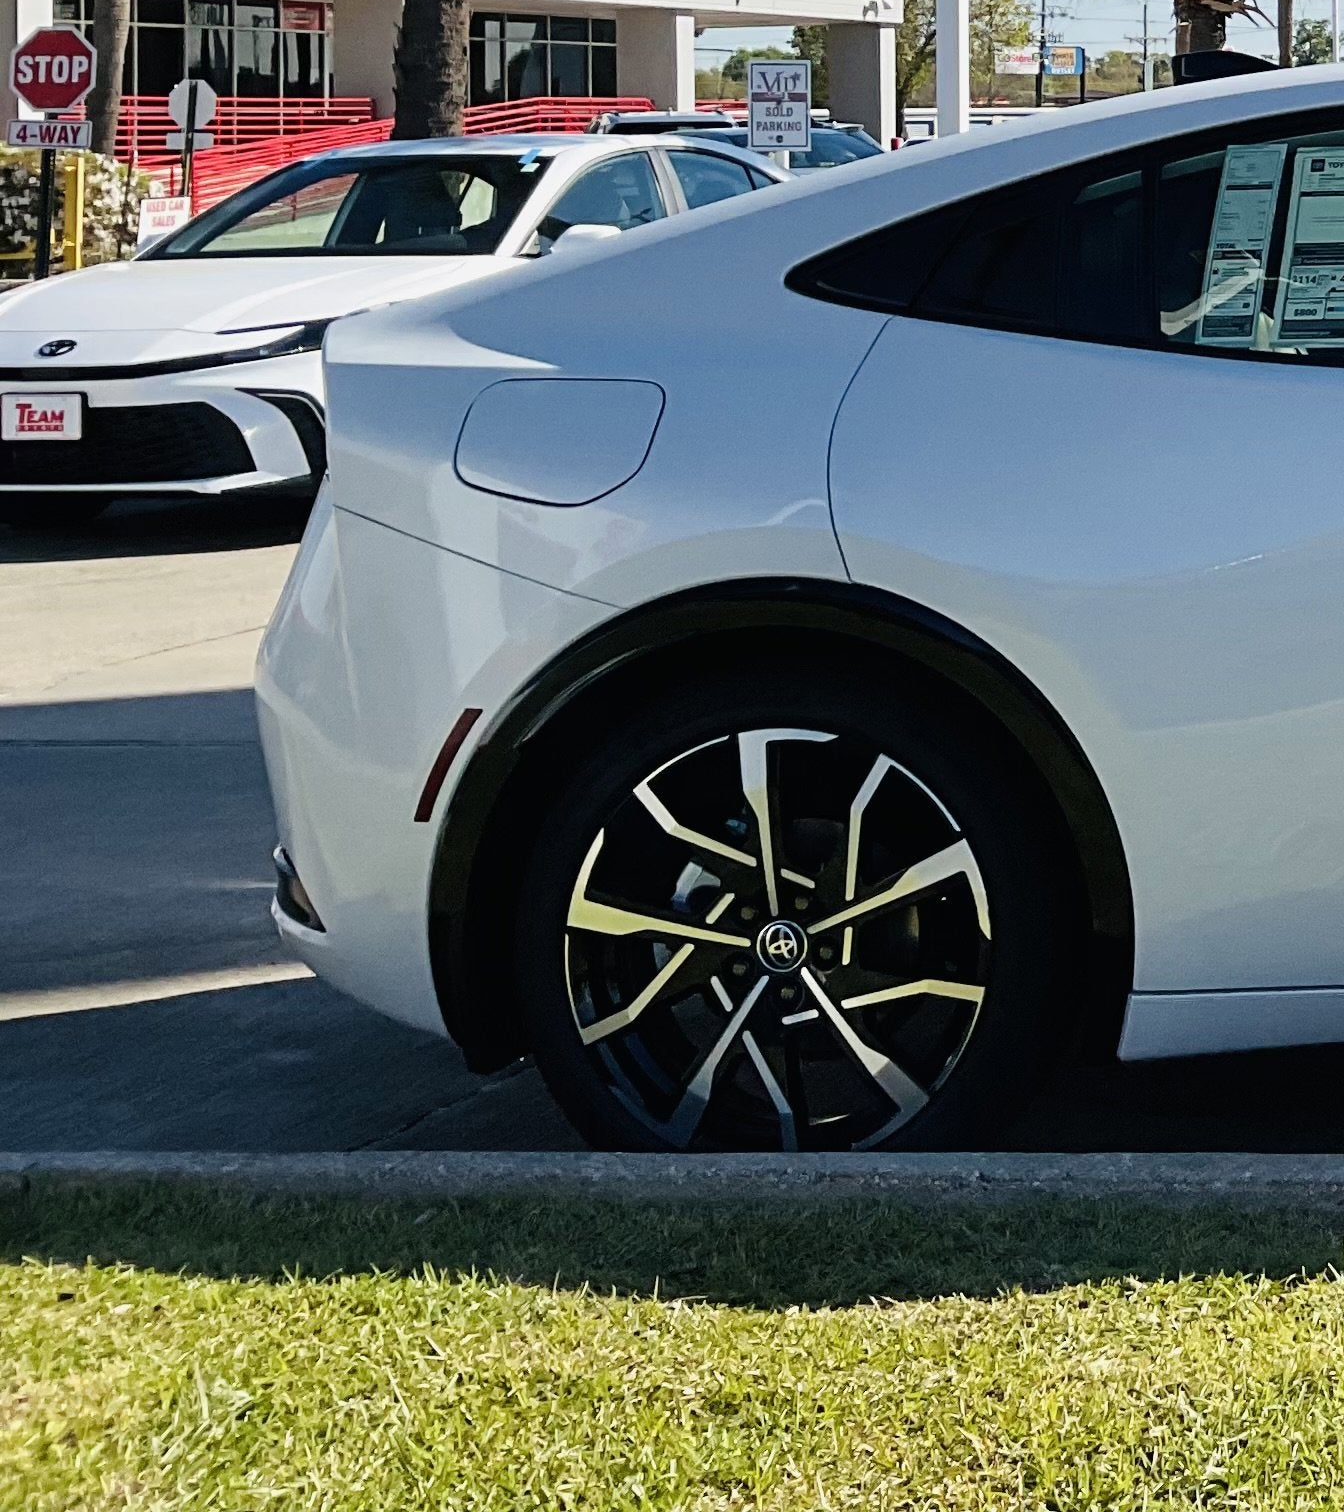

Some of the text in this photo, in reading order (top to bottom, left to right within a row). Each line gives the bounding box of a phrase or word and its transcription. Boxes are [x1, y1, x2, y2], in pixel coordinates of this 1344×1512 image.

[17, 55, 88, 84] STOP
[766, 107, 793, 117] SOLD
[756, 121, 802, 131] PARKING
[16, 125, 81, 144] 4-WAY
